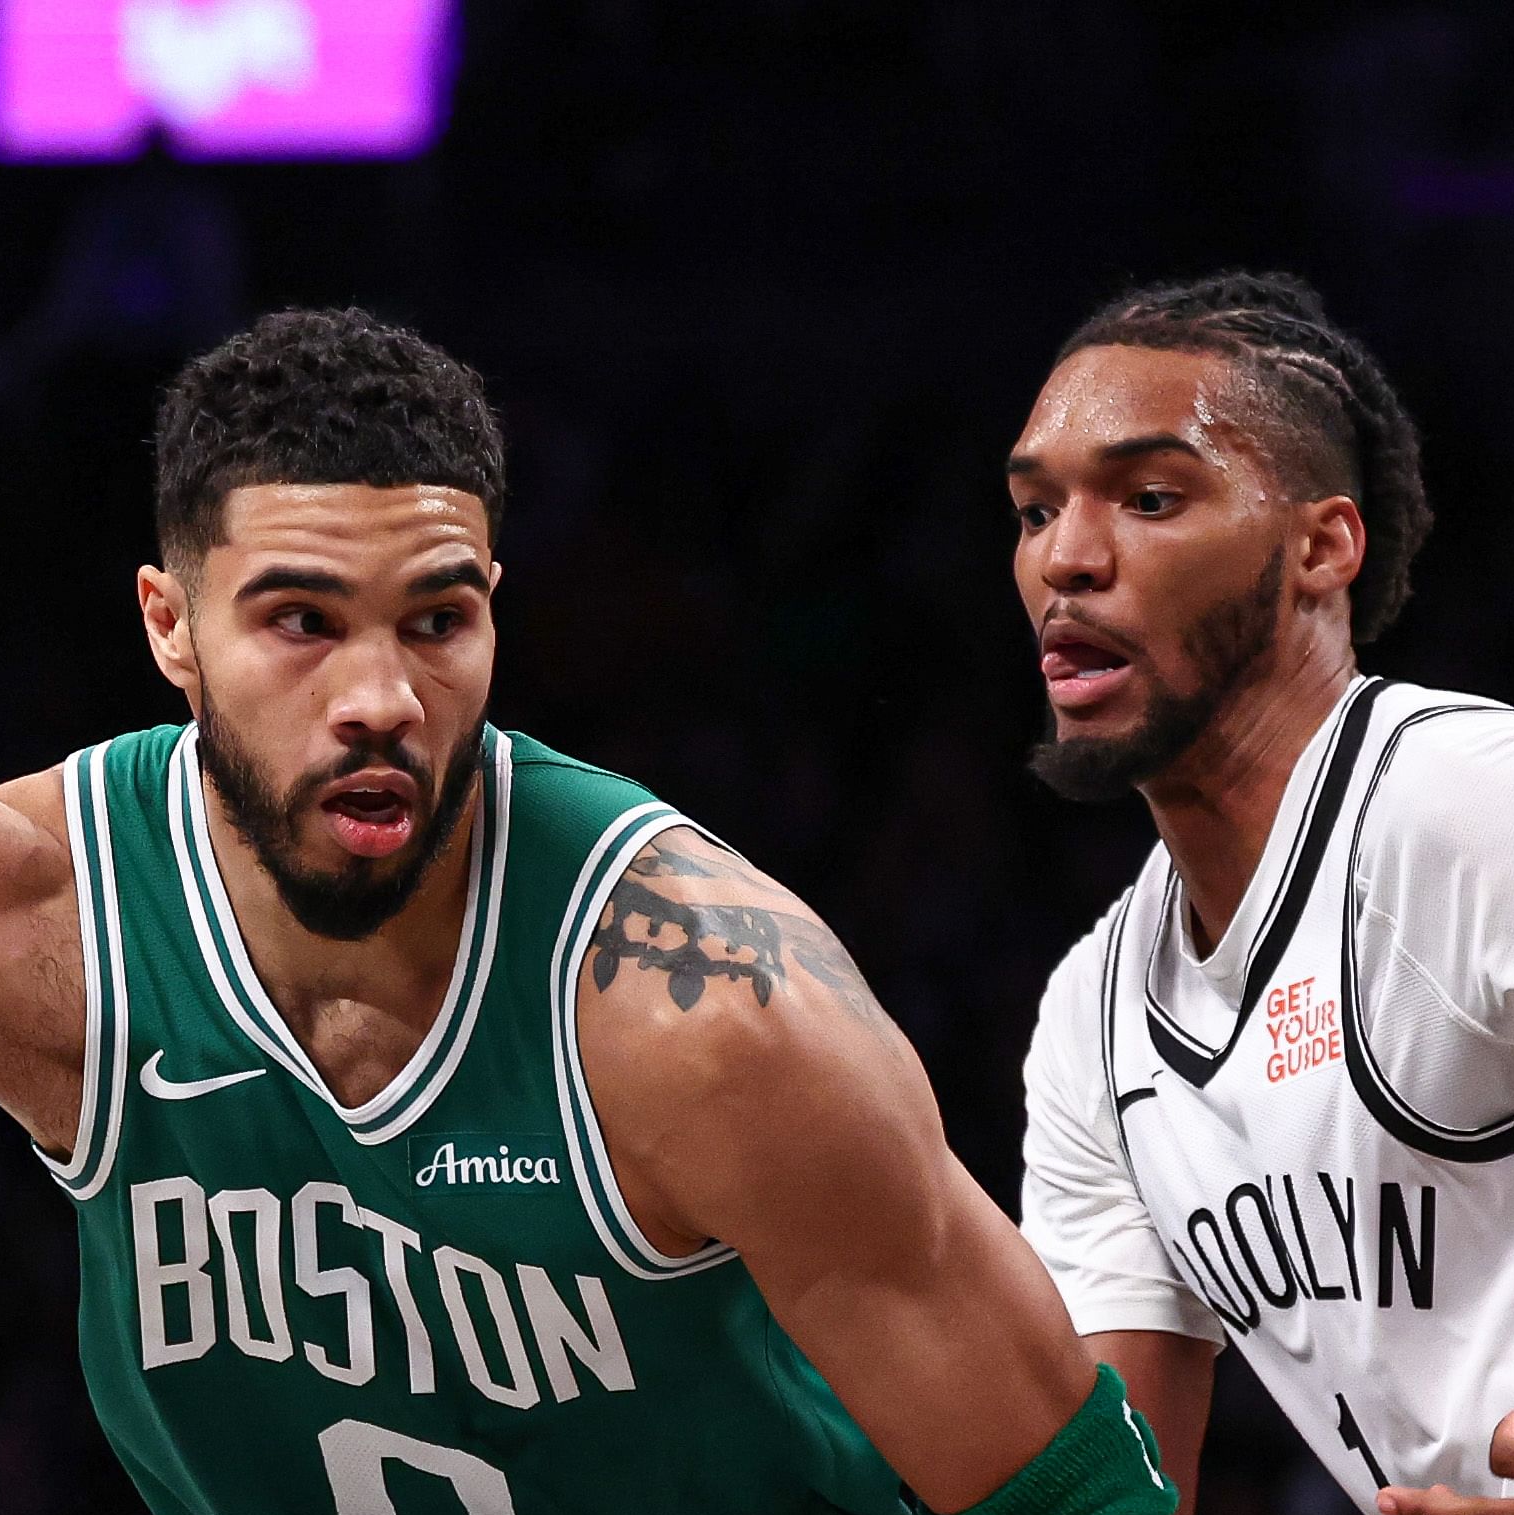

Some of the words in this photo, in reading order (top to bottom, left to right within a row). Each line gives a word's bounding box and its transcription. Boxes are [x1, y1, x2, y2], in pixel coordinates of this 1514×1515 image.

[1267, 976, 1316, 1018] GET
[1266, 1000, 1336, 1050] YOUR
[1267, 1029, 1342, 1083] GUIDE
[415, 1142, 561, 1187] Amica
[131, 1176, 637, 1410] BOSTON
